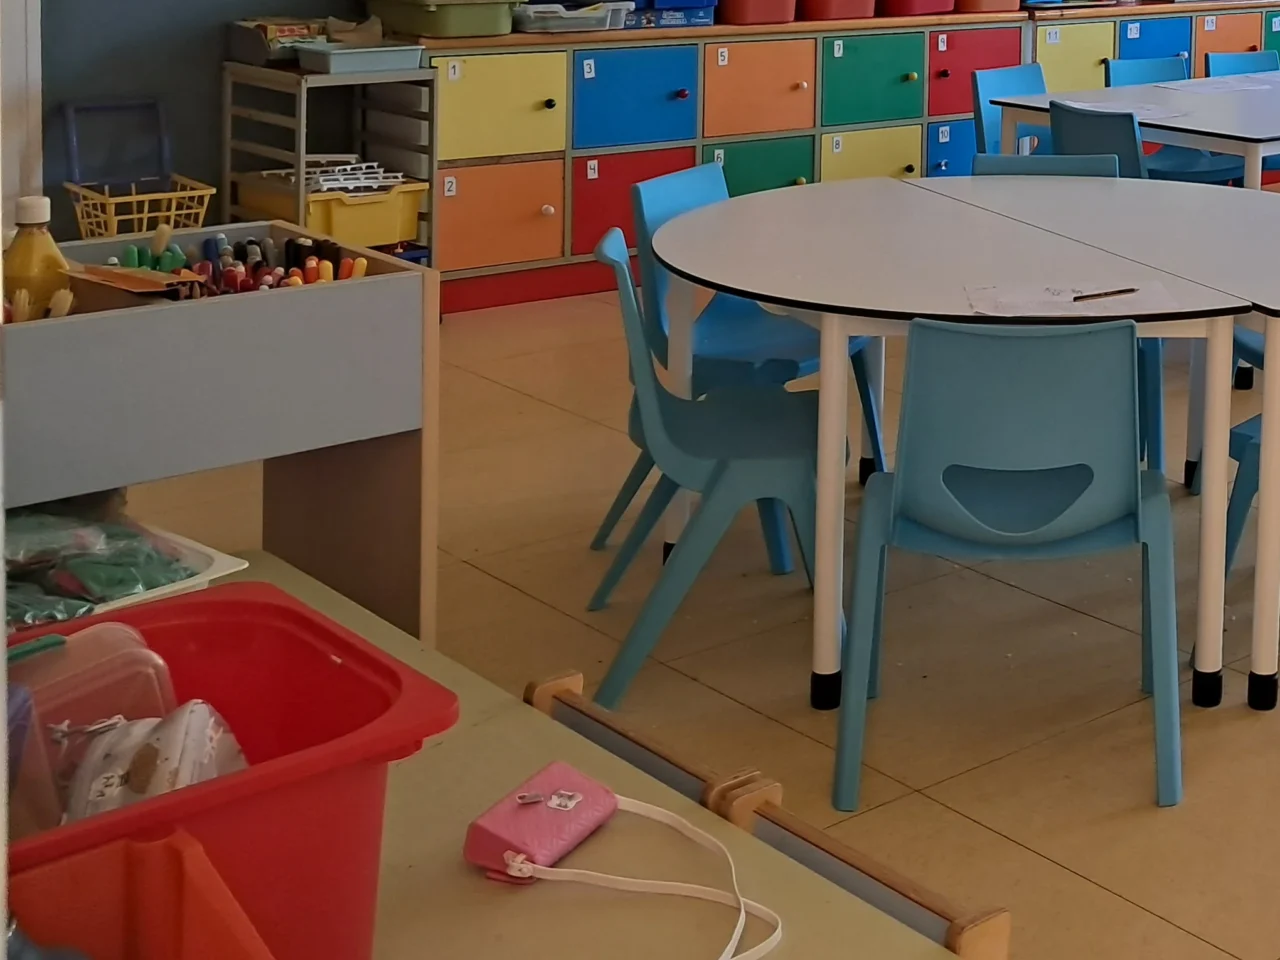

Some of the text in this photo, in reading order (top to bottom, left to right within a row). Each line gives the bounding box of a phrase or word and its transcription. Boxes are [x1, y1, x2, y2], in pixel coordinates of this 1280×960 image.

[720, 51, 726, 61] 5
[586, 63, 592, 73] 3
[941, 129, 949, 139] 10
[834, 140, 840, 150] 8
[589, 164, 596, 174] 4
[447, 180, 454, 192] 2
